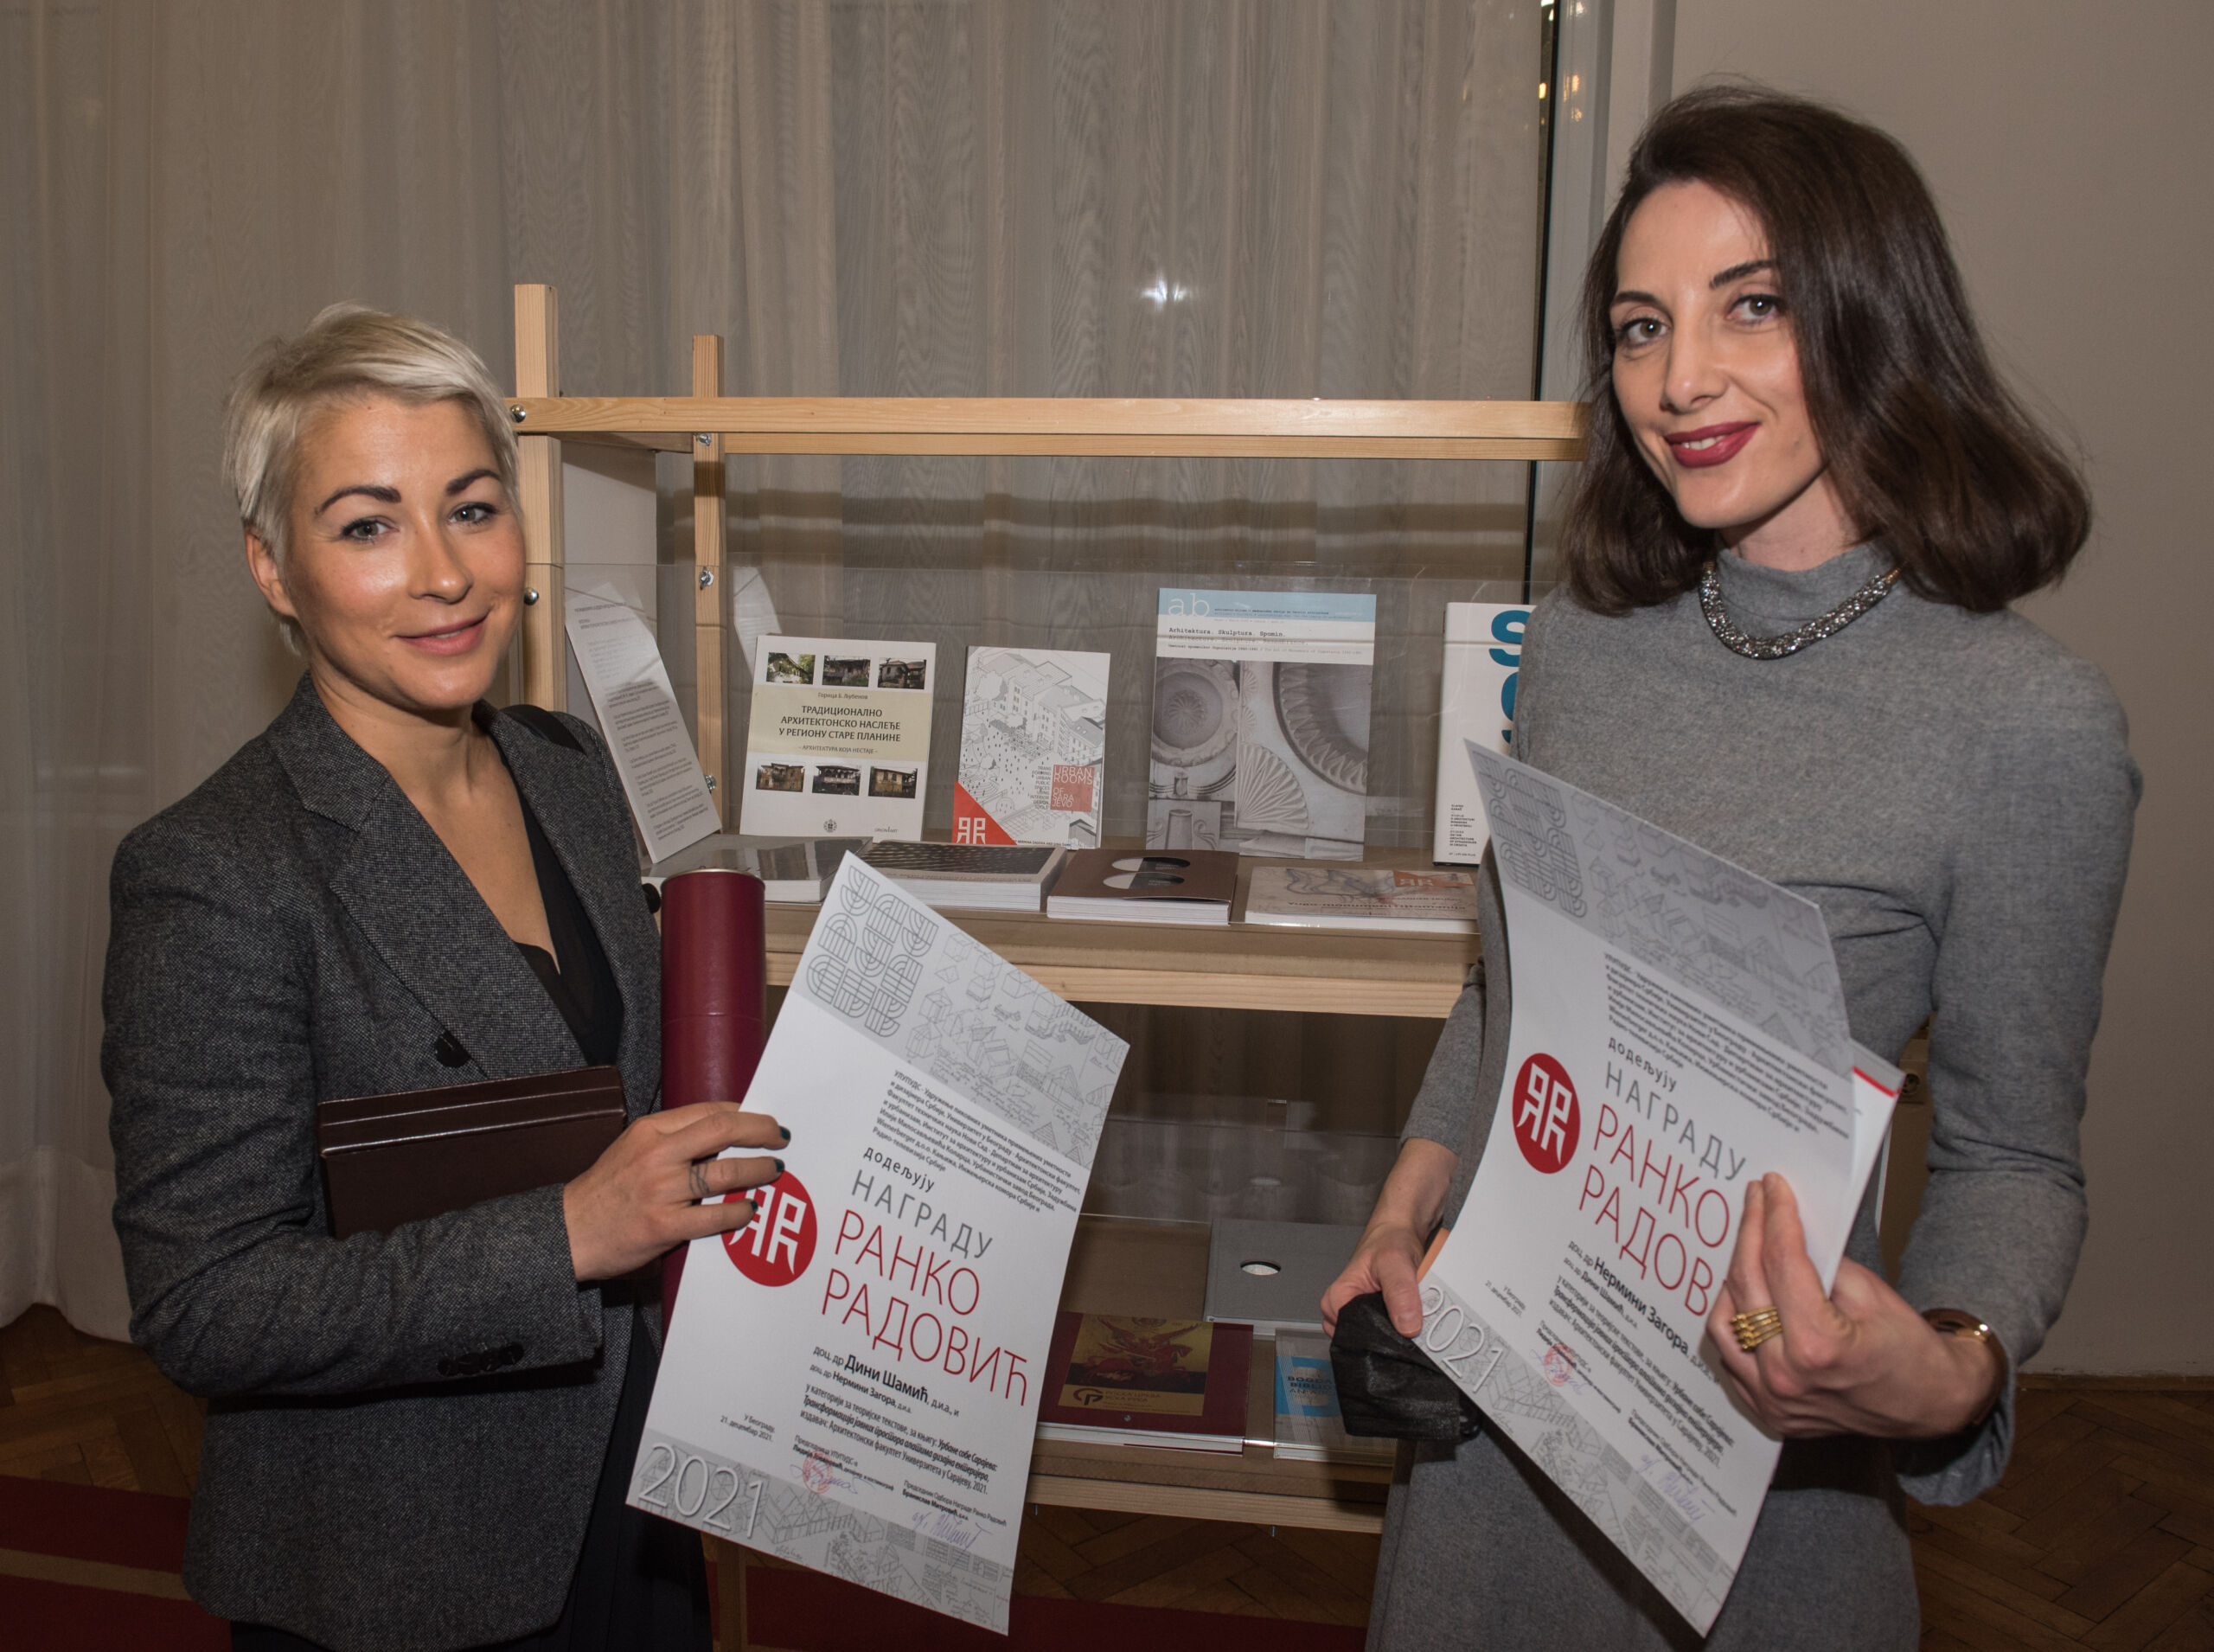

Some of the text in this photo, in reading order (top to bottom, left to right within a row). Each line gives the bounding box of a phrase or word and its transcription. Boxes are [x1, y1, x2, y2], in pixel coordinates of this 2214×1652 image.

[781, 716, 900, 730] АРХИТЕКТОНСКО НАСЛЕЂЕ
[786, 729, 827, 738] РЕГИОНУ
[829, 731, 854, 740] СТАРЕ
[857, 733, 900, 742] ПЛАНИНЕ
[802, 706, 882, 717] ТРАДИЦИОНАЛНО
[1053, 773, 1093, 784] ROOMS
[1053, 794, 1074, 803] SARA
[1054, 766, 1092, 777] URBAN
[1053, 798, 1072, 807] JEVO
[1608, 1036, 1677, 1093] додељују
[1605, 1060, 1747, 1181] НАГРАДУ
[862, 1147, 935, 1194] додељују
[1593, 1103, 1731, 1249] РАНКО
[851, 1169, 994, 1259] НАГРАДУ
[1578, 1163, 1719, 1317] РАДОВ
[835, 1208, 980, 1316] РАНКО
[1593, 1256, 1648, 1316] Нермини
[822, 1267, 1027, 1406] РАДОВИЋ
[812, 1346, 832, 1362] доц.
[831, 1354, 845, 1367] др
[843, 1354, 881, 1382] Дини
[882, 1369, 930, 1405] Шамић,
[930, 1399, 953, 1416] д.и.а.,
[639, 1445, 764, 1539] 2021
